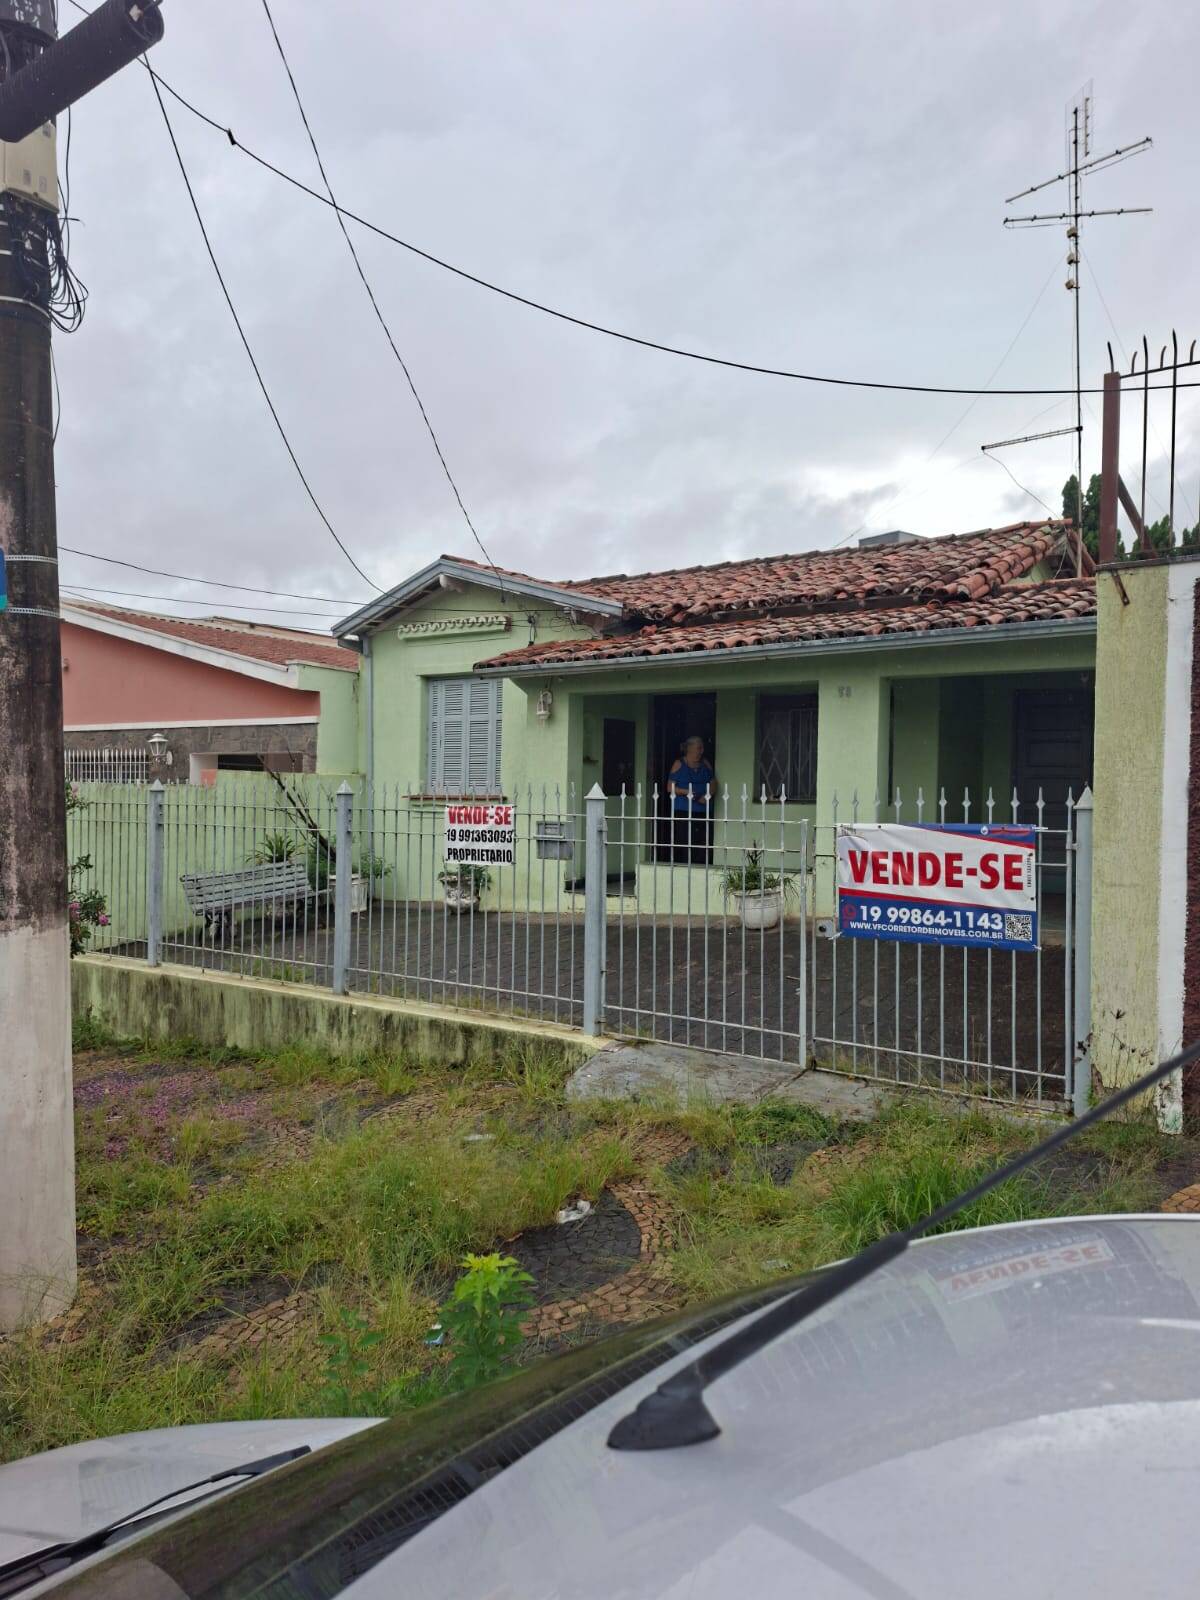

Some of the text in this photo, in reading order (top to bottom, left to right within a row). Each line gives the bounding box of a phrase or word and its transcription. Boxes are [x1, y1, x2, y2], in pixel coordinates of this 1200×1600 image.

[448, 805, 512, 826] VENDE-SE
[446, 829, 513, 843] 19 991363093
[447, 847, 512, 863] PROPRIETARIO
[848, 849, 1024, 891] VENDE-SE
[859, 905, 1003, 930] 19 99864-1143
[850, 921, 1003, 940] WWW.VFCORRETORDEIMOVEIS.COM.BR
